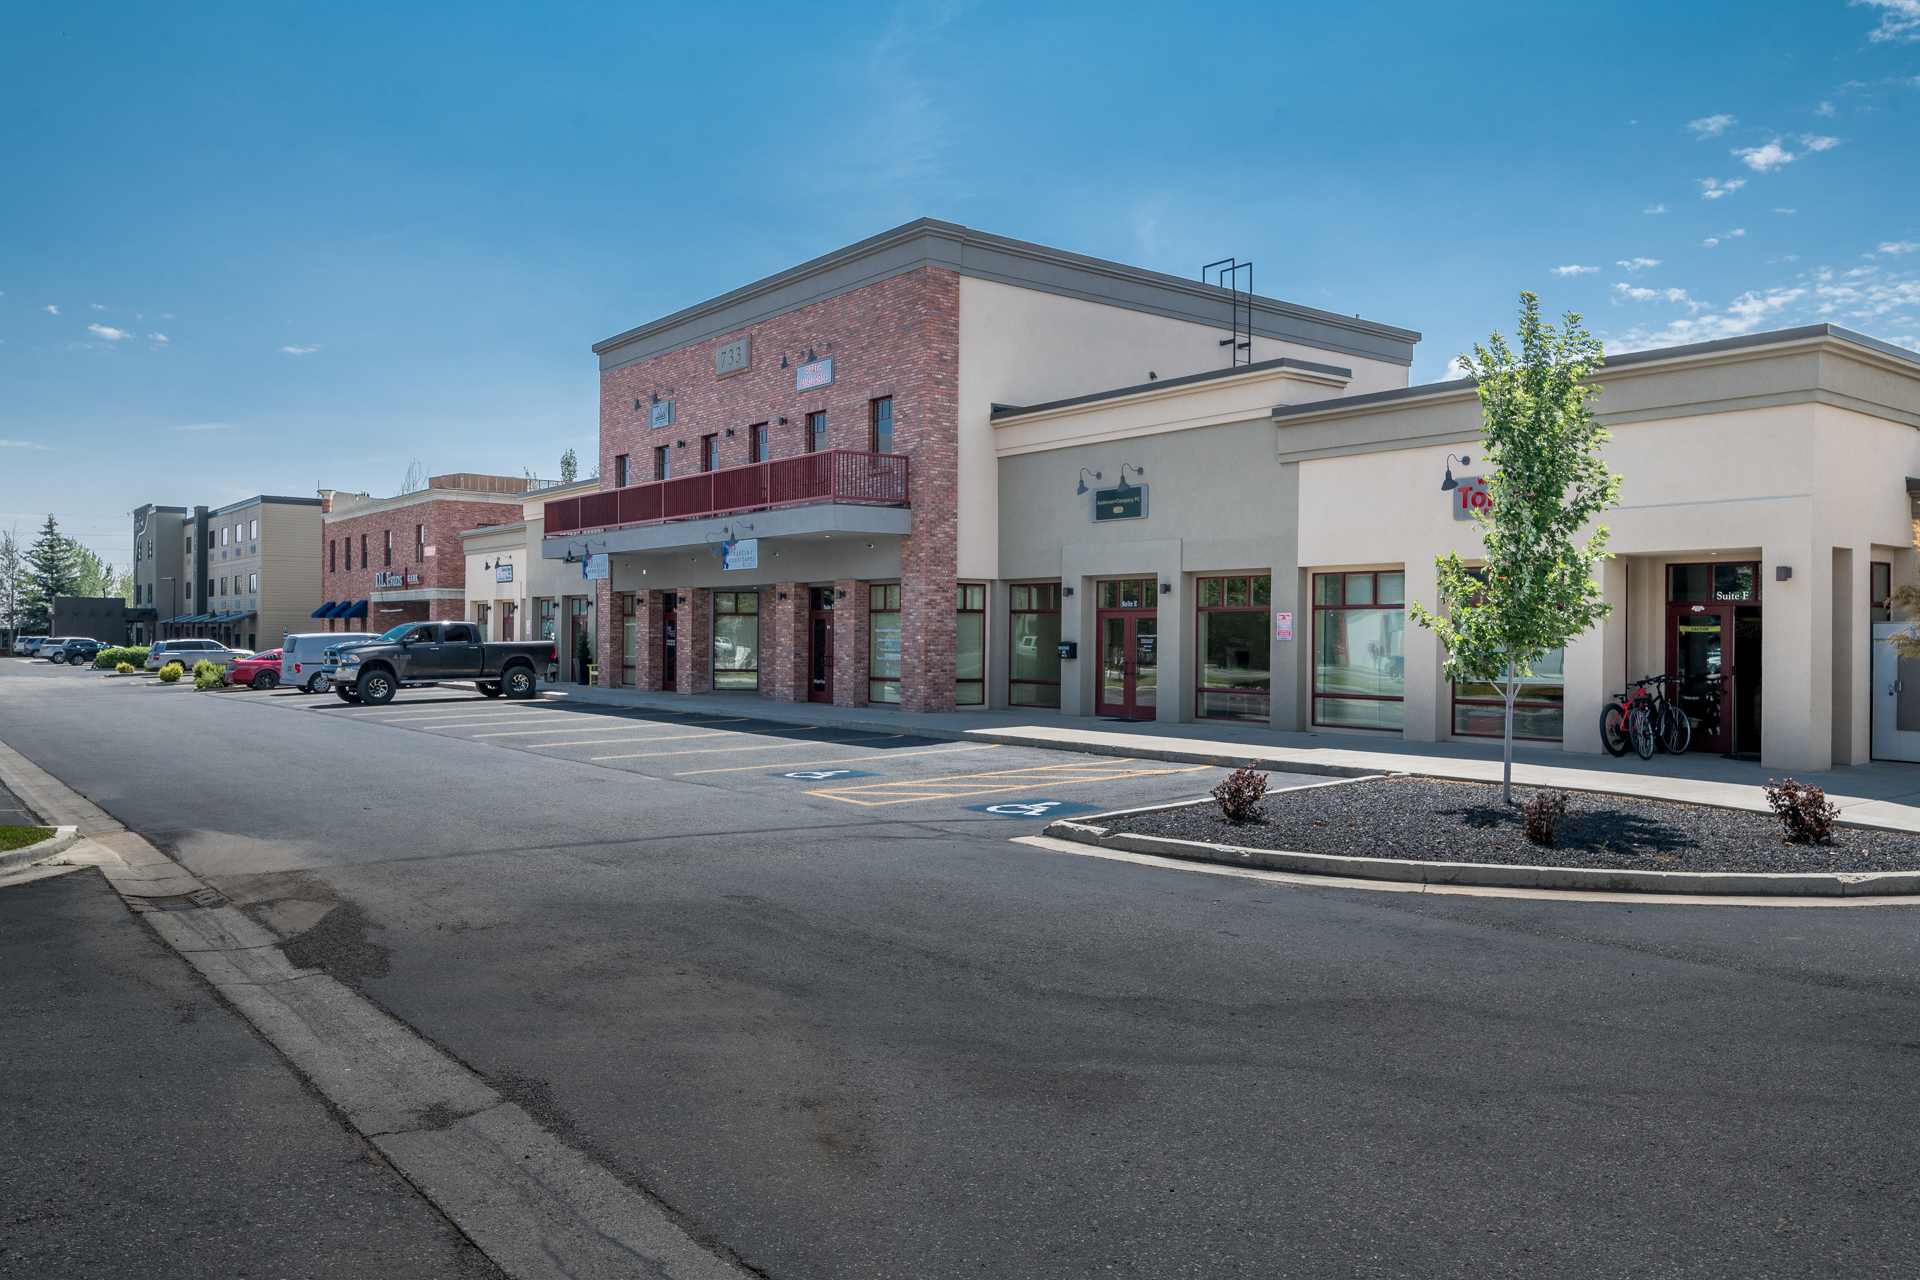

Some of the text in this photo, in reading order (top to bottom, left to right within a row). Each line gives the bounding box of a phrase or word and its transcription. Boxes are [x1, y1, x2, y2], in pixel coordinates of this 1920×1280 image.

[721, 347, 741, 368] 733
[806, 363, 823, 376] SPACE
[800, 373, 828, 388] AVAILABLE
[386, 571, 403, 587] Evans
[407, 574, 419, 582] BANK
[1716, 591, 1749, 600] Suite F
